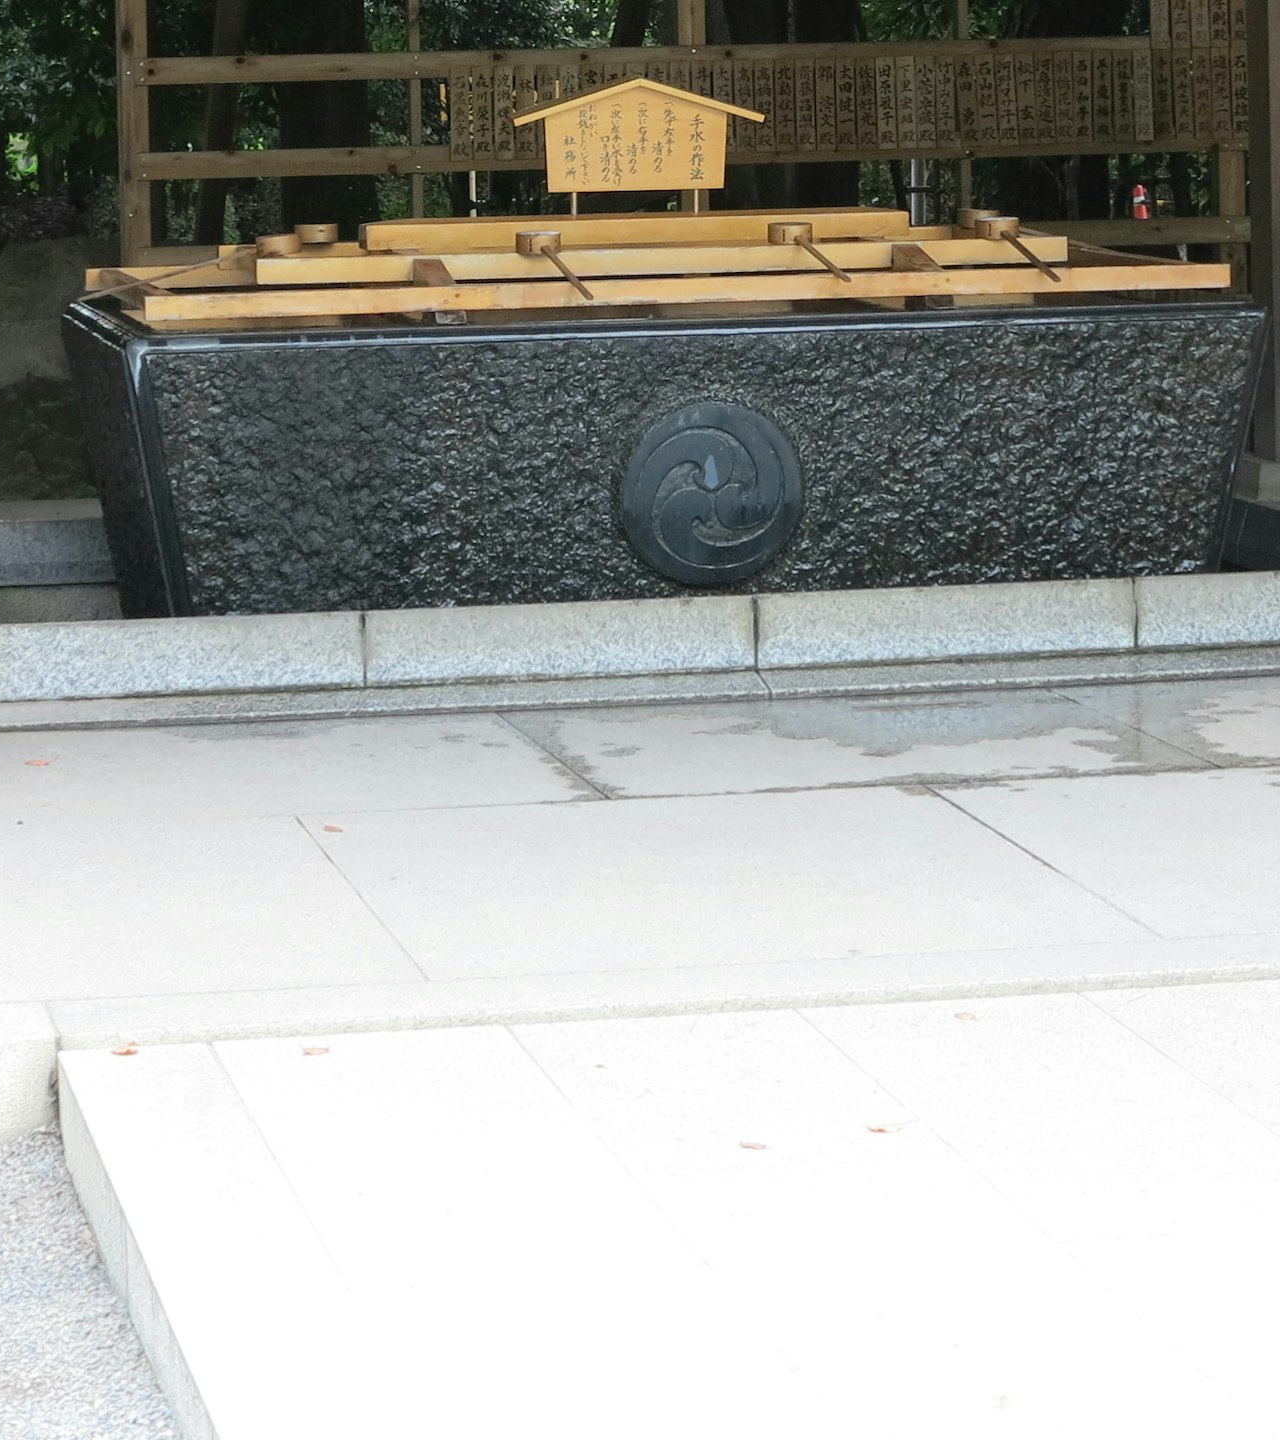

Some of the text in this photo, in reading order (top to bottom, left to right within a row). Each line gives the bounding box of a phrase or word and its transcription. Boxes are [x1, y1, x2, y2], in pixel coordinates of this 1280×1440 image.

[689, 113, 707, 182] 手水の作法
